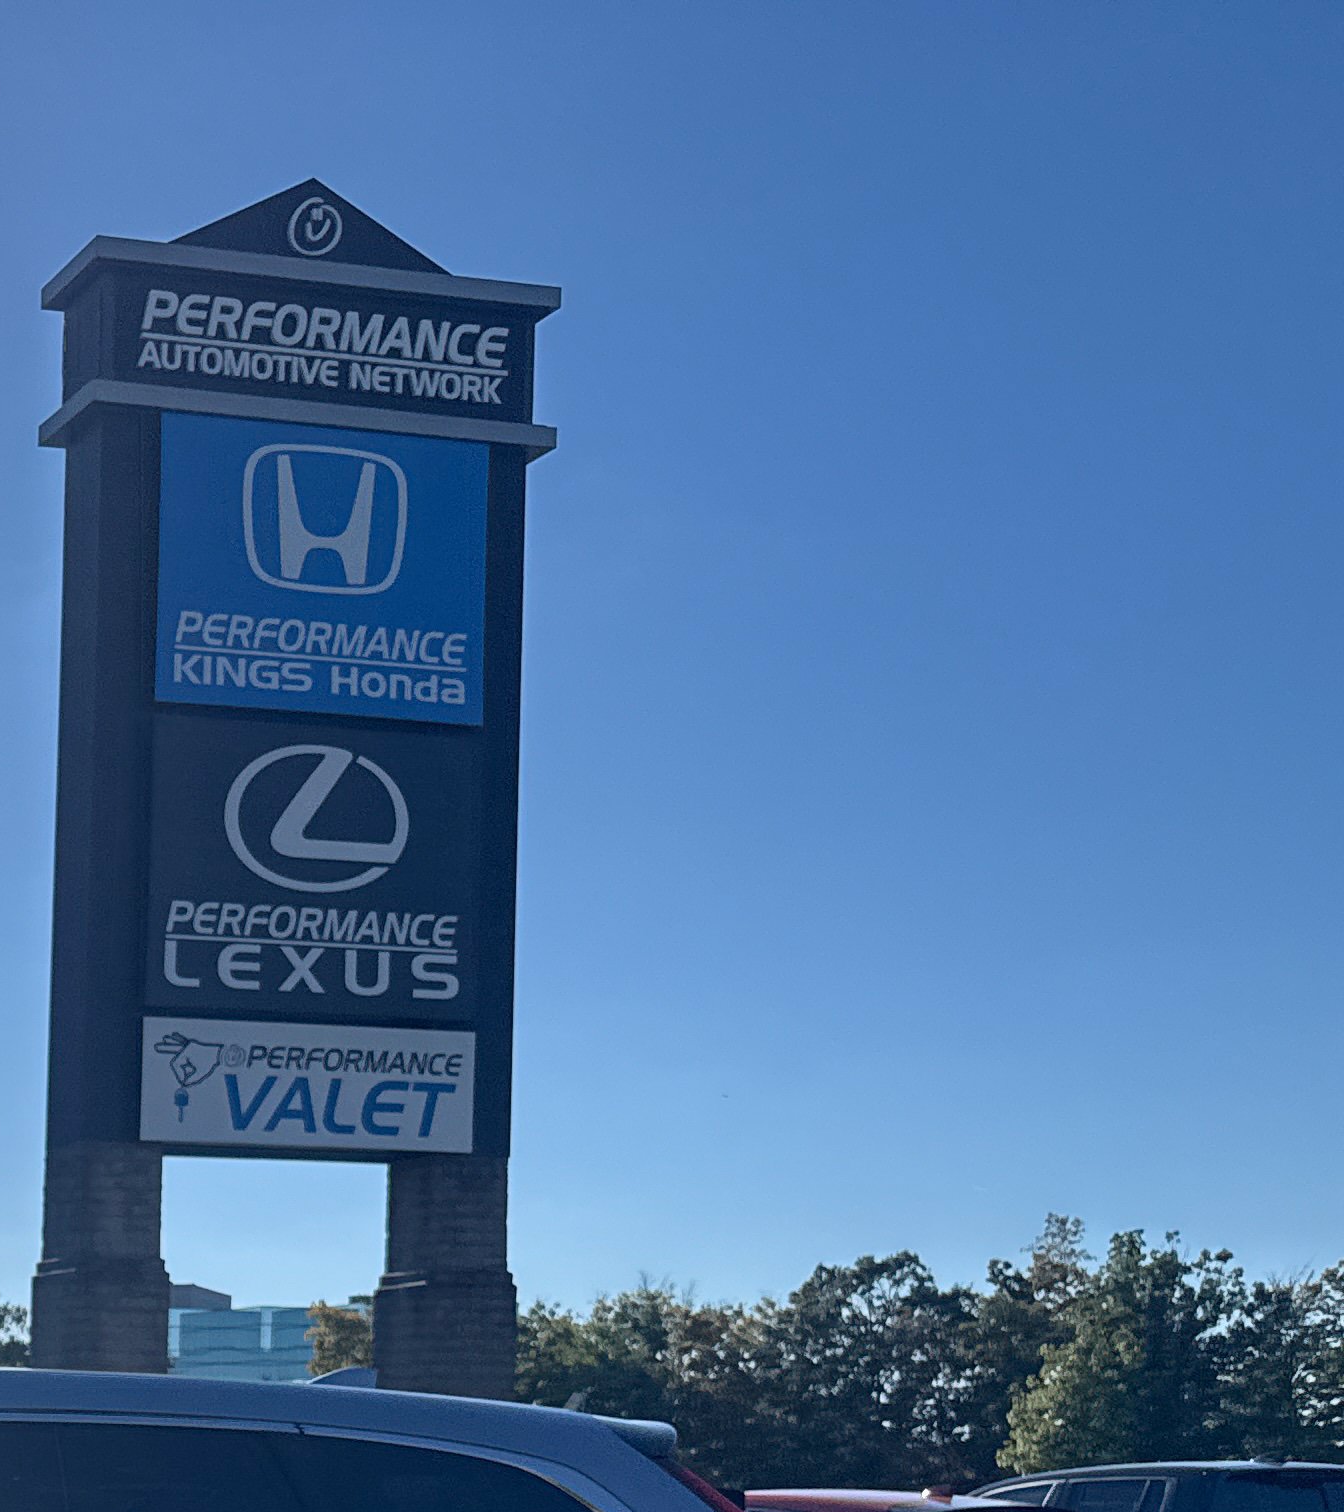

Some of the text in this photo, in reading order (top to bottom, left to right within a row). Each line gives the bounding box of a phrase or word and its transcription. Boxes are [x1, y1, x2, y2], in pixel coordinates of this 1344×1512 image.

[141, 288, 510, 369] PERFORMANCE
[136, 340, 503, 405] AUTOMOTIVE NETWORK
[174, 610, 468, 666] PERFORMANCE
[172, 652, 466, 706] KINGS Honda
[165, 899, 459, 948] PERFORMANCE
[163, 939, 460, 1001] LEXUS
[246, 1044, 464, 1078] PERFORMANCE
[223, 1073, 457, 1139] VALET
